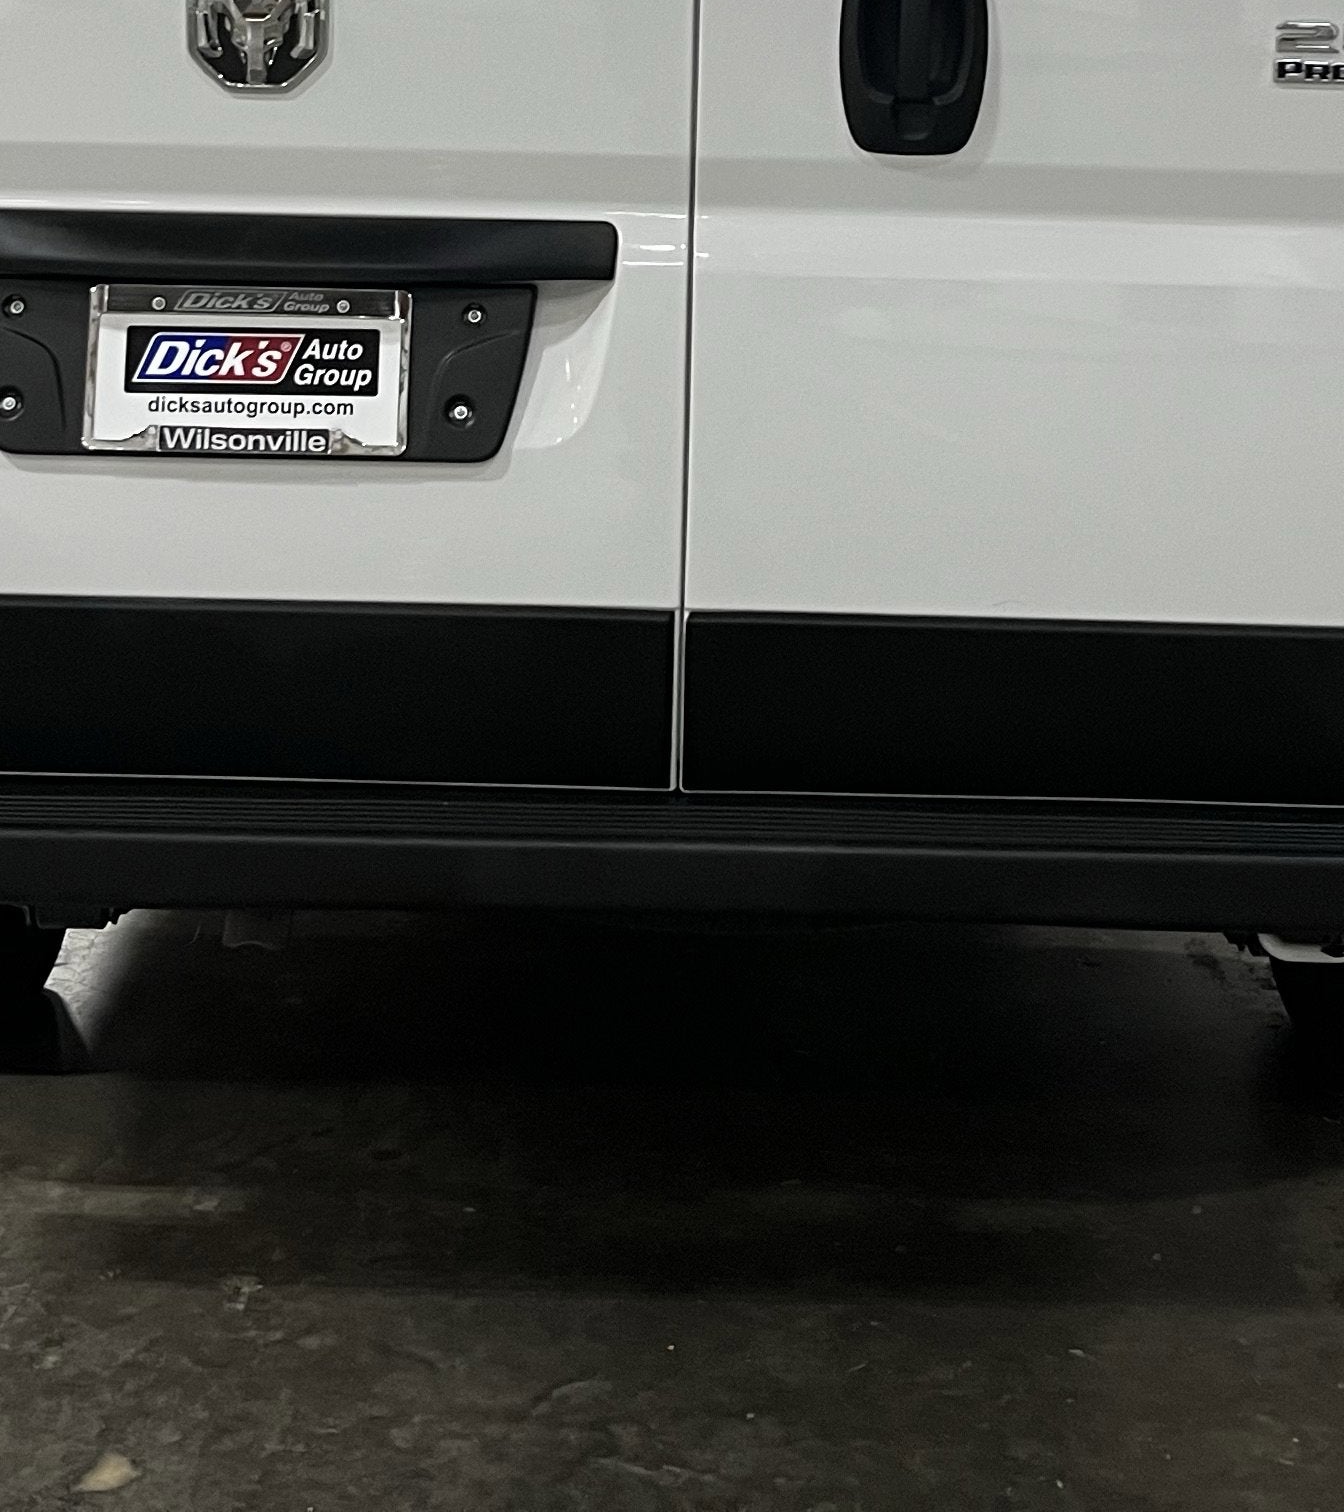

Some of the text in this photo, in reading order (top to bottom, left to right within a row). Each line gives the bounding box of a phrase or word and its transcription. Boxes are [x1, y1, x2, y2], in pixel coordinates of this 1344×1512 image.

[182, 291, 324, 309] Dick's Auto
[283, 301, 330, 314] Group
[145, 338, 363, 378] Dick's Auto
[293, 363, 372, 392] Group
[147, 396, 354, 418] dicksautogroup.com
[163, 426, 327, 453] Wilsonville
